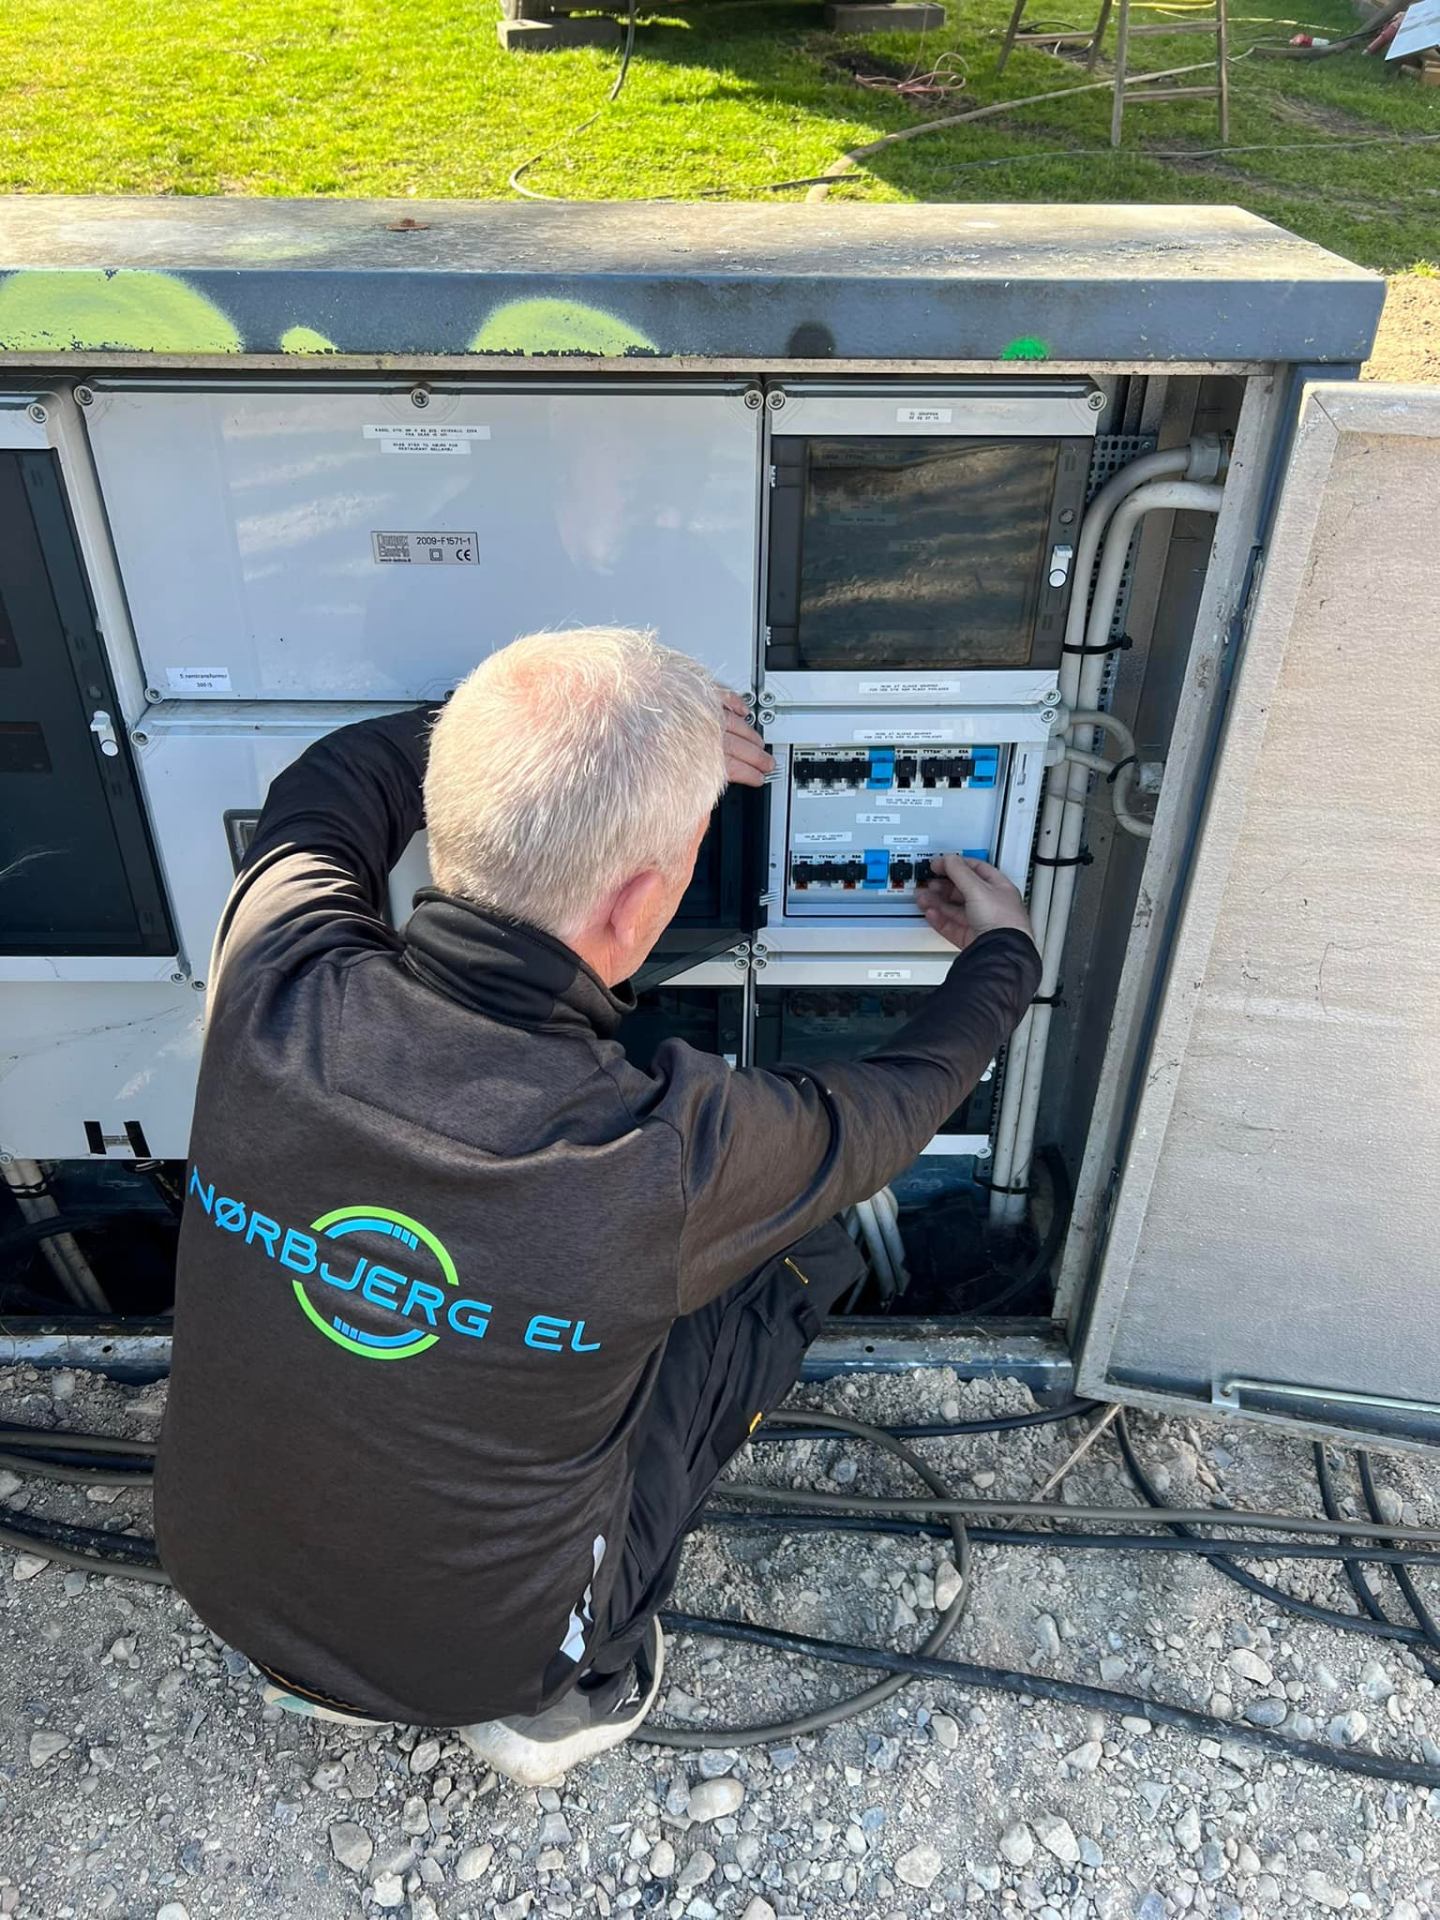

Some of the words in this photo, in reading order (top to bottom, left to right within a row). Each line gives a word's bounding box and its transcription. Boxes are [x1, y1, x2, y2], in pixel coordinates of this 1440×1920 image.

[416, 536, 471, 545] 2009-F1571-1
[456, 548, 471, 561] CE
[189, 1165, 494, 1338] NØRBJERG
[524, 1314, 601, 1352] EL
